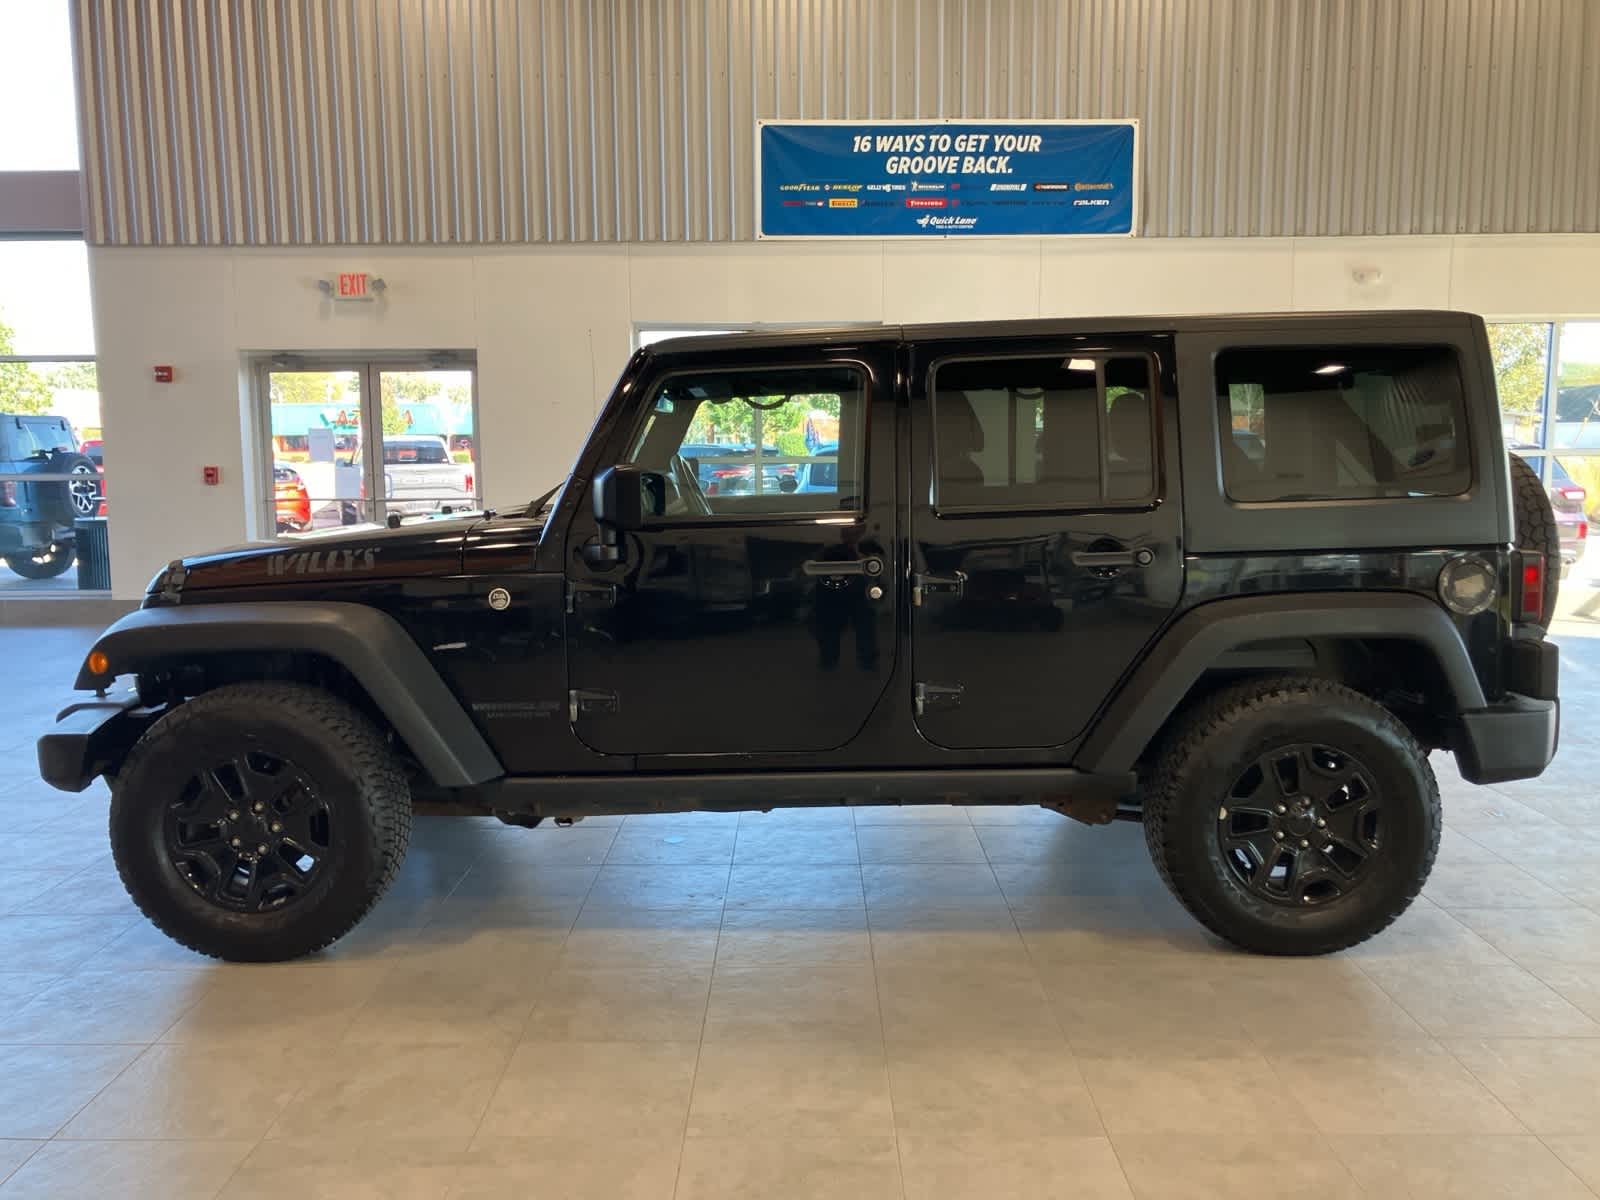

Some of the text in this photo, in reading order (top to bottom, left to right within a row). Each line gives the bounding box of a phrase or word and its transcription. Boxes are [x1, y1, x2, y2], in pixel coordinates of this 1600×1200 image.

[853, 134, 1042, 153] 16 WAYS TO GET YOUR
[885, 155, 1014, 175] GROOVE BACK.
[930, 216, 977, 226] Quick Lane
[339, 273, 367, 296] EXIT
